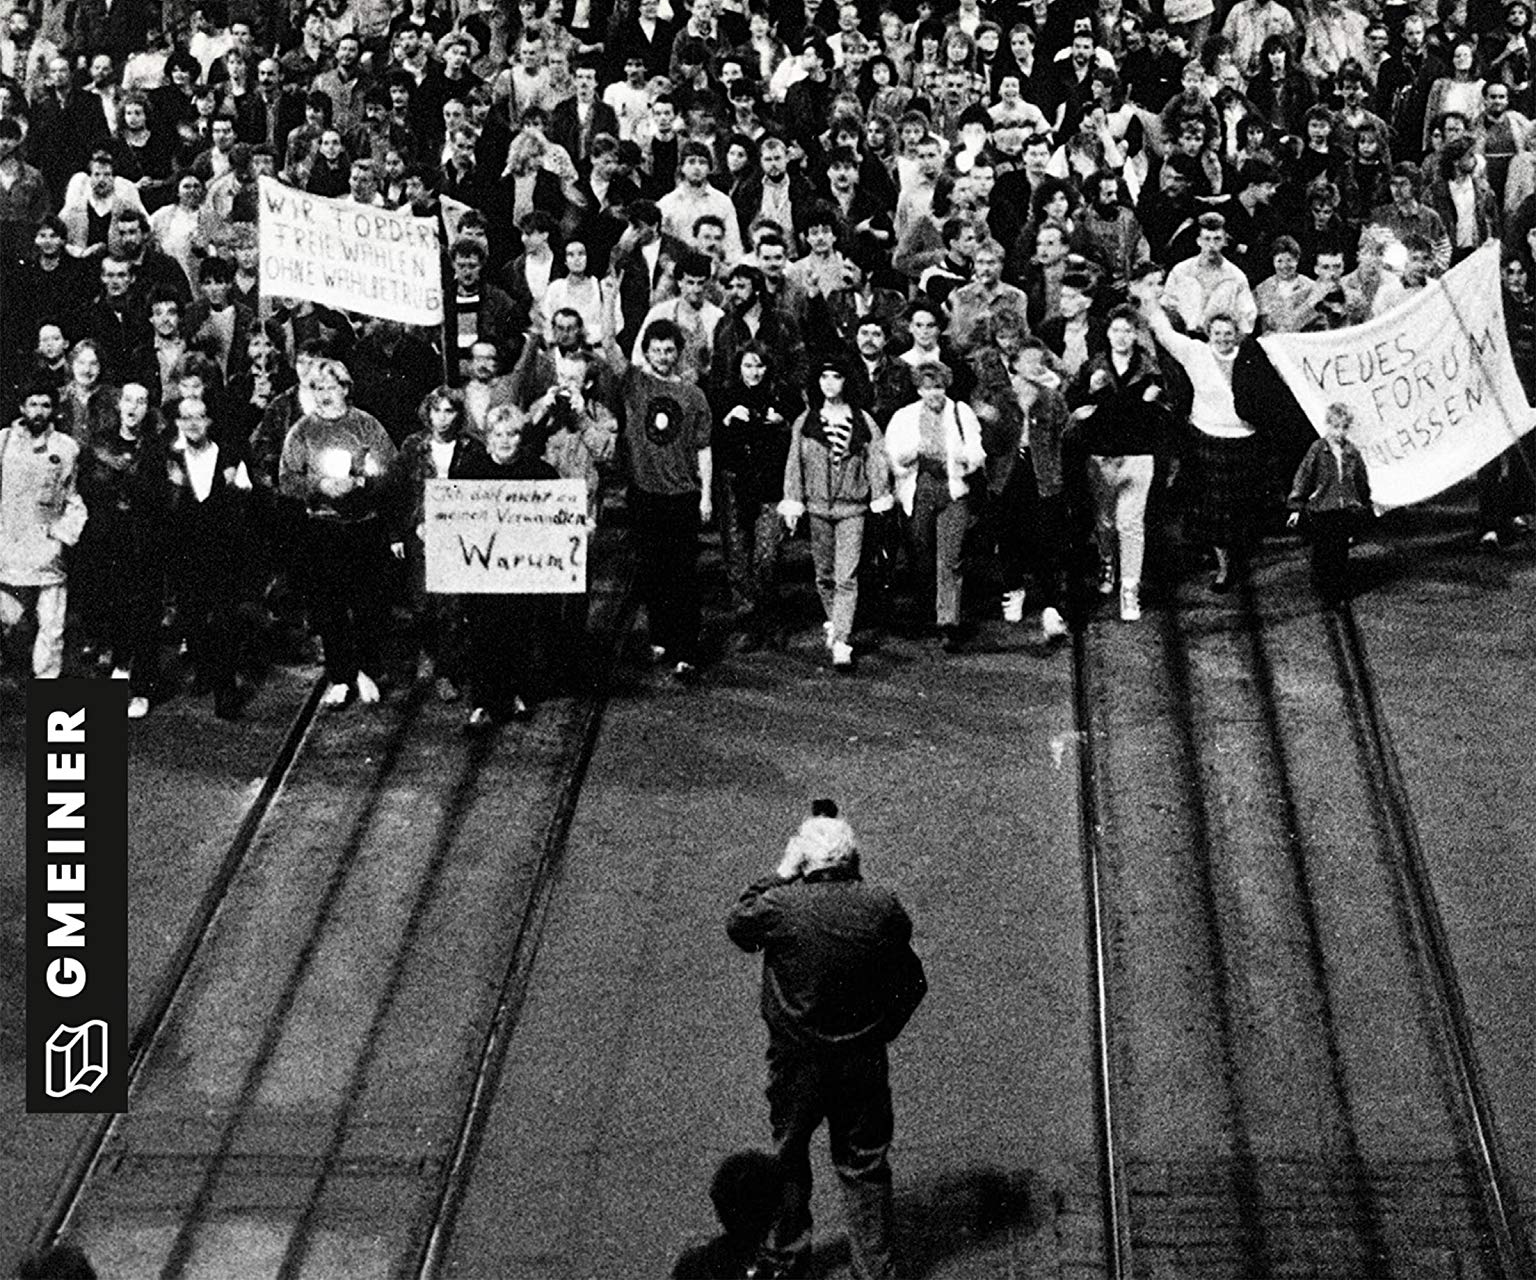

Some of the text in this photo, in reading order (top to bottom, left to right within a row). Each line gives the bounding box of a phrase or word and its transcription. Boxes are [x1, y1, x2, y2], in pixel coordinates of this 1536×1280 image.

[265, 190, 314, 223] WIR
[1302, 332, 1417, 391] NEUES
[1371, 326, 1497, 421] FORUM
[457, 532, 580, 582] Warum?
